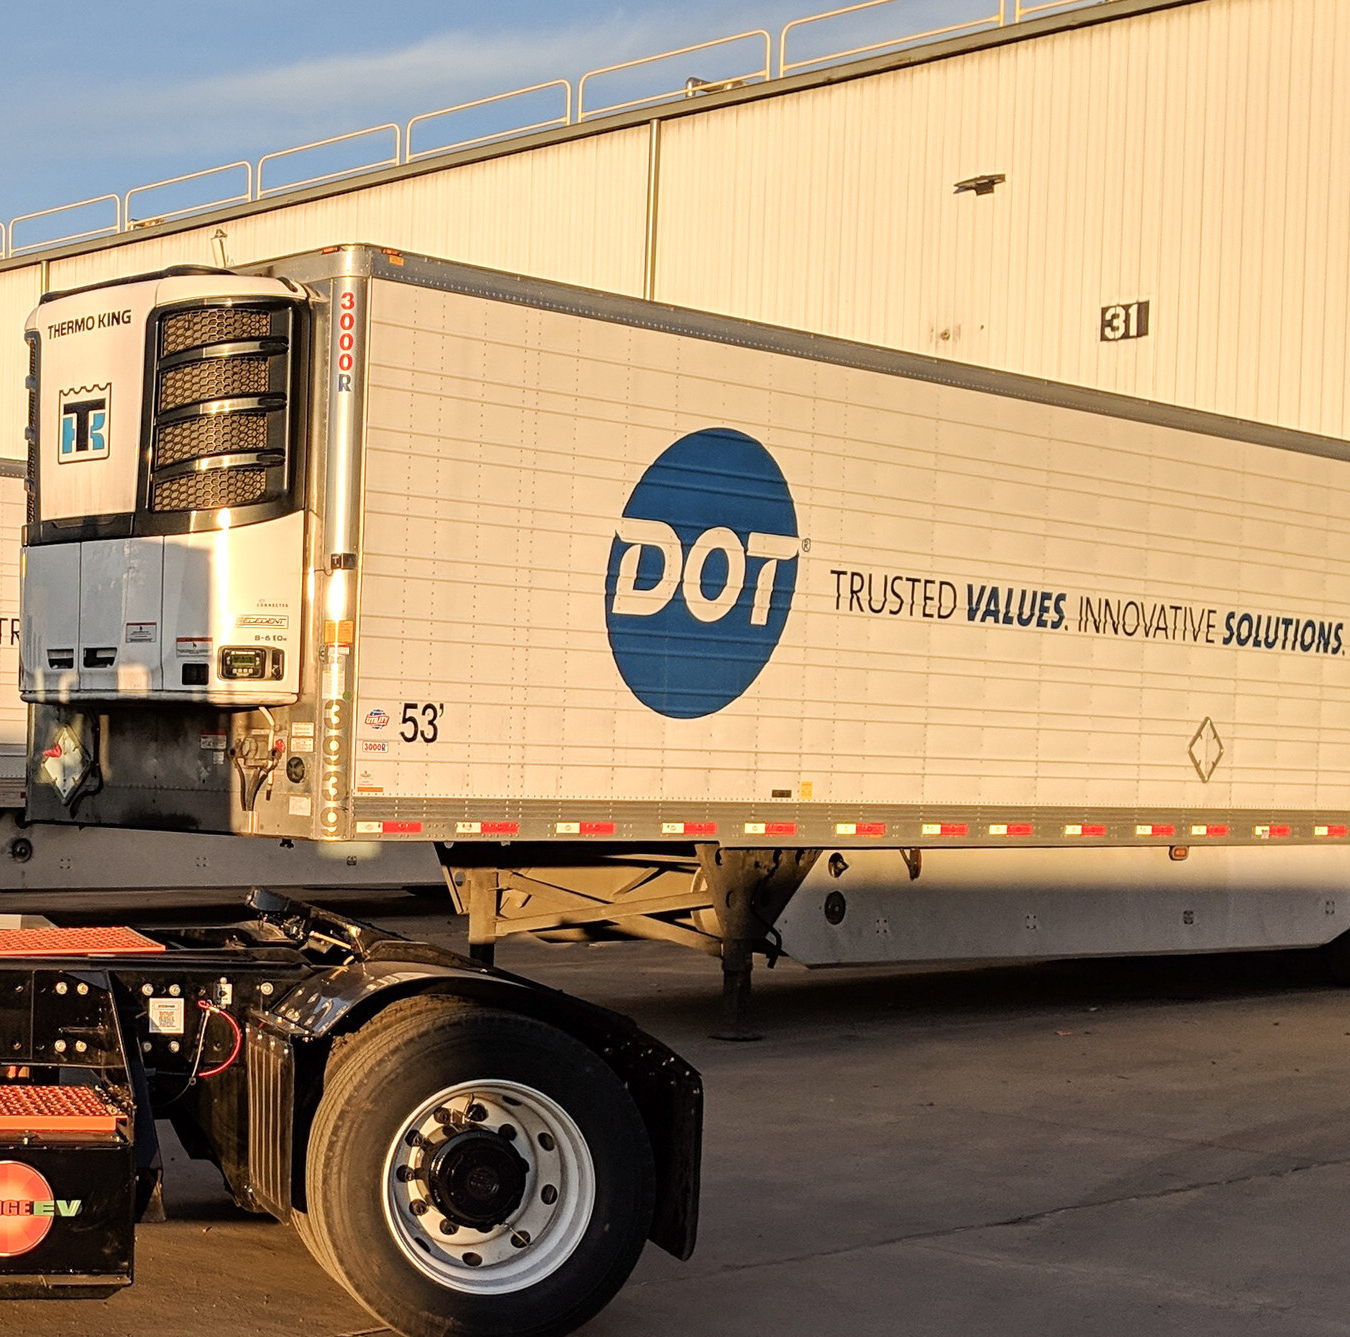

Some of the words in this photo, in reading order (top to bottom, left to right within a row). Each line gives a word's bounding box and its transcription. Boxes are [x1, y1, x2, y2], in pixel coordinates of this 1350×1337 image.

[47, 315, 95, 340] THERMO
[97, 309, 132, 329] KING
[337, 291, 355, 392] 3000R
[1104, 304, 1139, 340] 31
[612, 516, 799, 626] DOT
[830, 569, 957, 620] TRUSTED
[966, 583, 1069, 631] VALUES.
[1077, 596, 1218, 644] INNOVATIVE
[1222, 611, 1346, 656] SOLUTIONS.
[399, 702, 444, 743] 53'
[33, 1200, 82, 1217] EV
